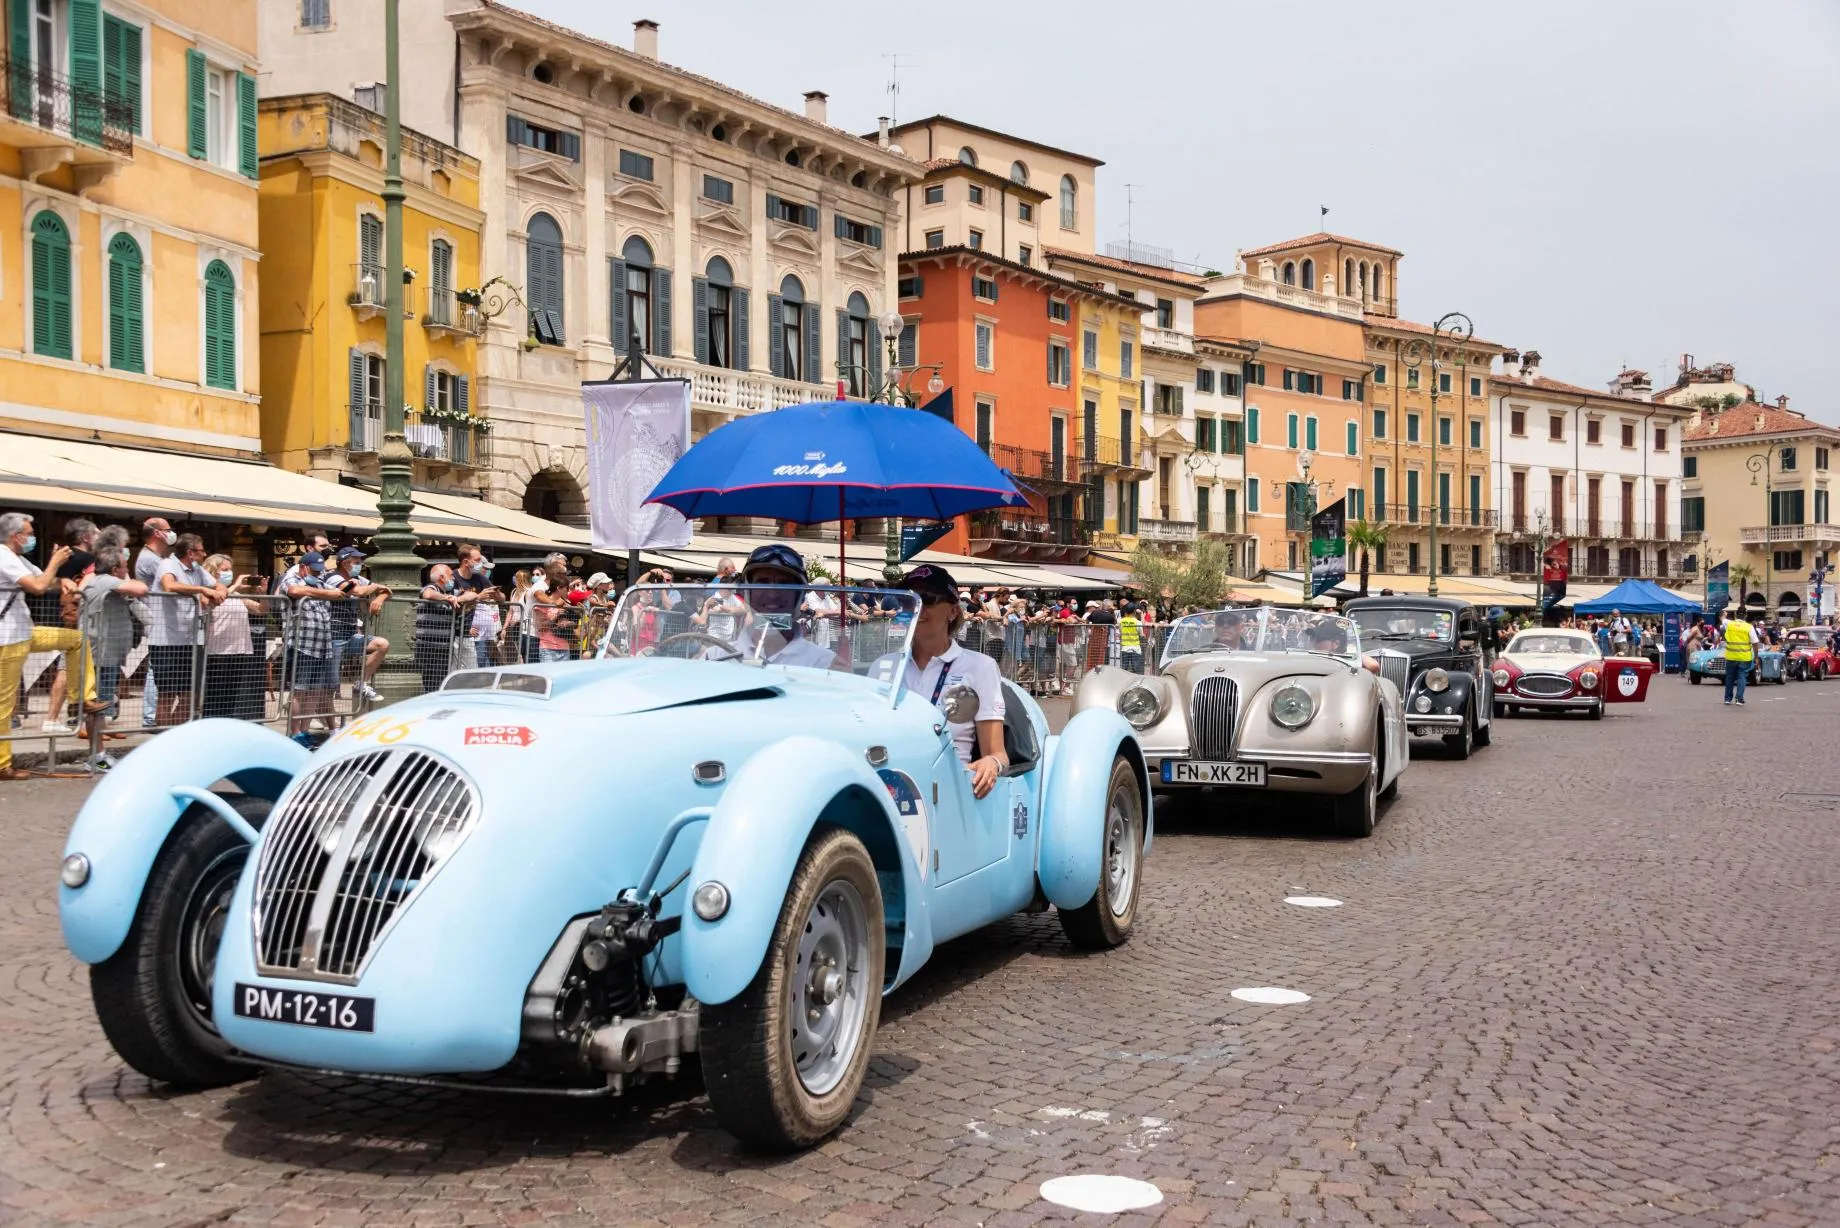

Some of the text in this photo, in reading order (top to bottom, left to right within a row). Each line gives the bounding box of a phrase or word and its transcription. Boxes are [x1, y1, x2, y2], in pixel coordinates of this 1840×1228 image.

[773, 461, 847, 478] 1000 Miglia
[1452, 544, 1471, 552] BANCA
[1622, 677, 1635, 686] 149
[472, 727, 520, 735] 1000
[468, 735, 523, 745] MIGLIA
[1177, 764, 1199, 780] FN
[1210, 765, 1232, 782] XK
[1236, 766, 1259, 783] 2H
[244, 987, 358, 1028] PM-12-16
